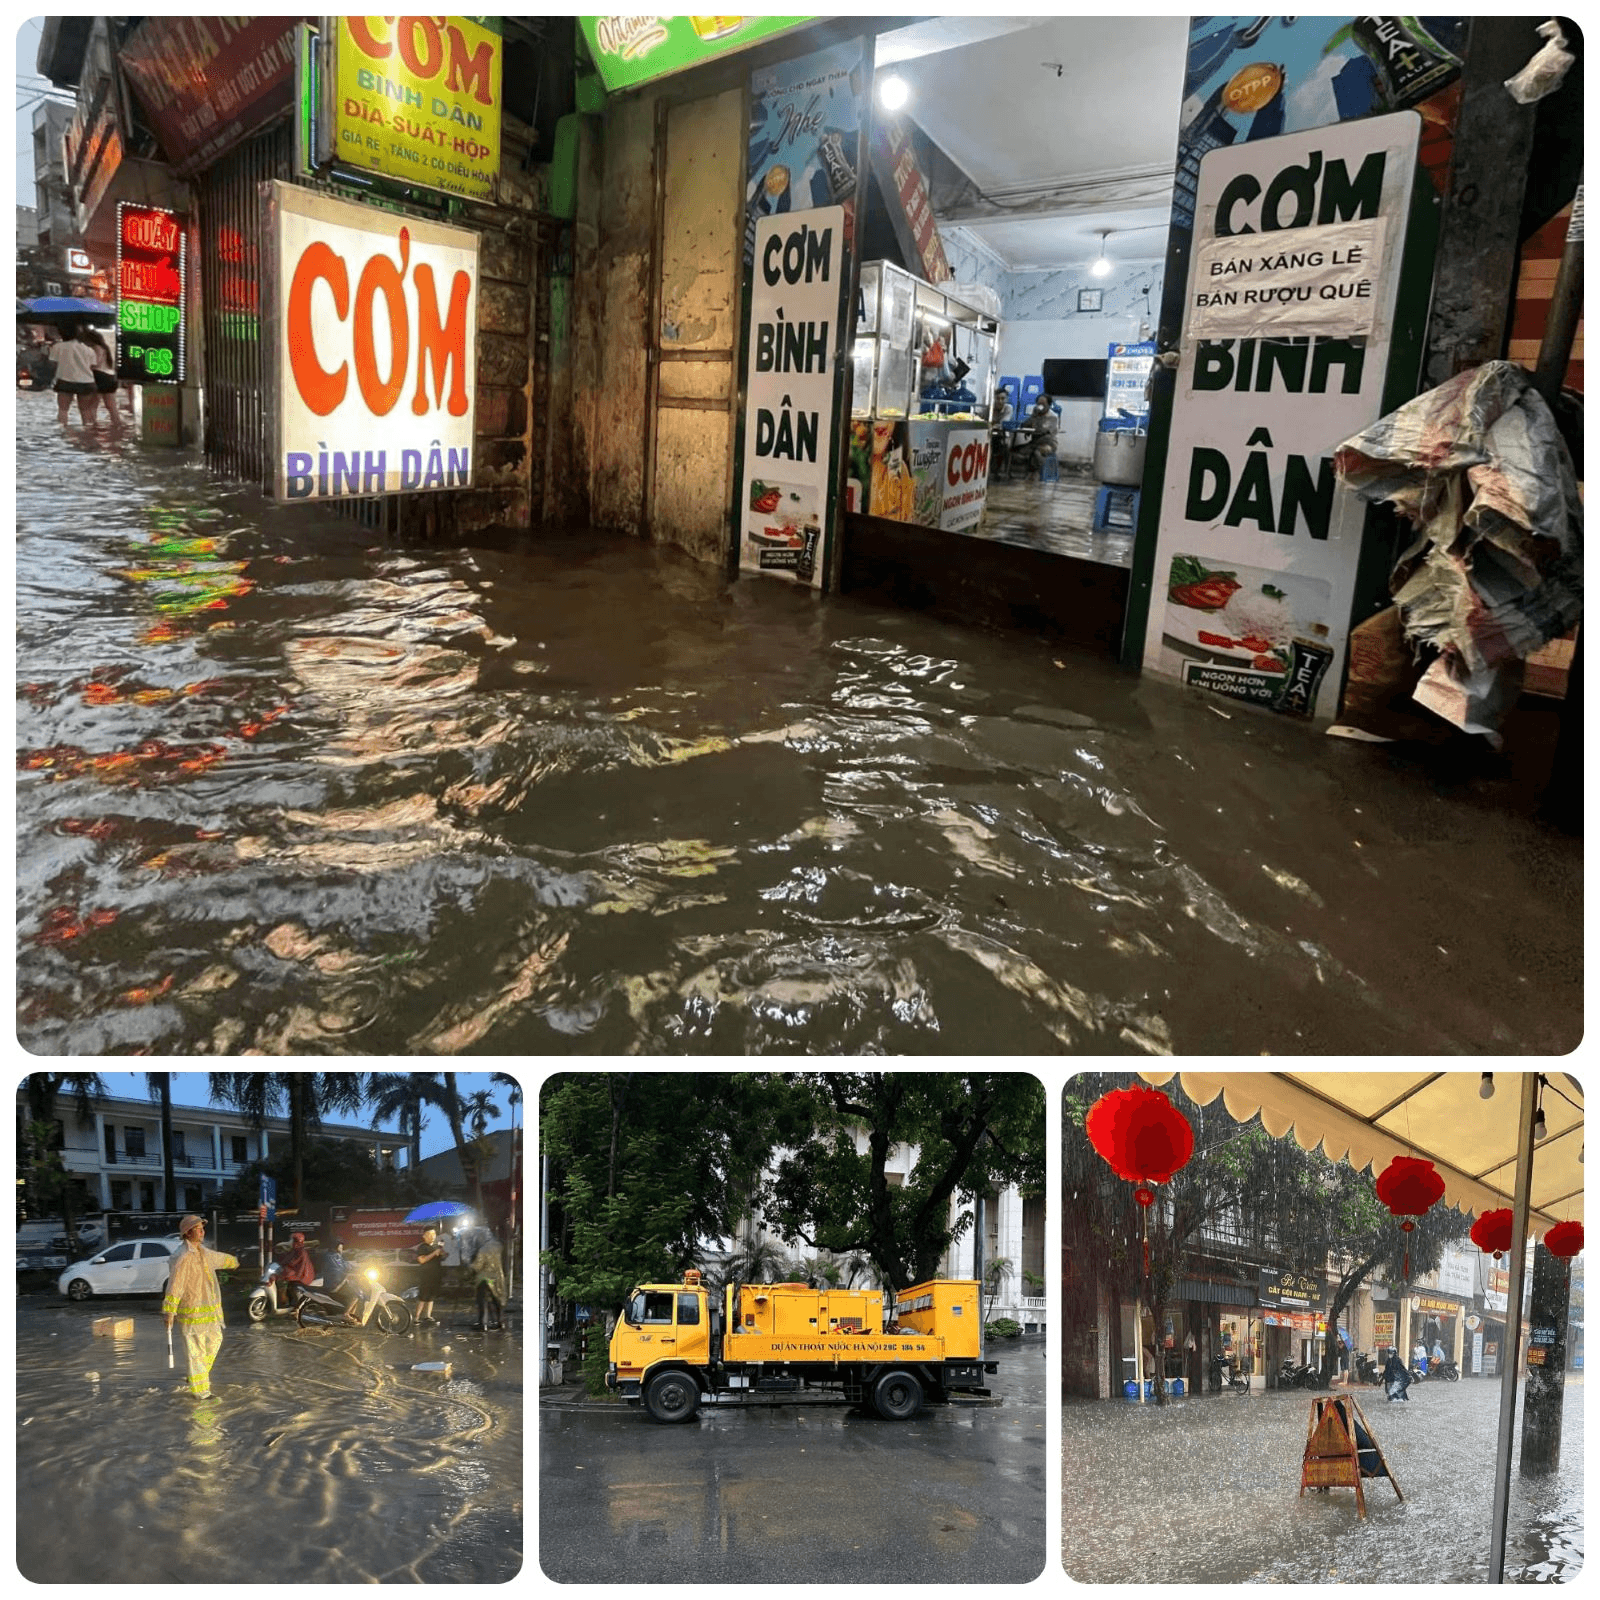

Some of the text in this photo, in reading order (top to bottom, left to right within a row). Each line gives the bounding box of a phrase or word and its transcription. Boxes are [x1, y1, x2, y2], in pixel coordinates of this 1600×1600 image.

[356, 67, 483, 132] BÌNH DÂN
[1229, 75, 1272, 101] OTPP
[1214, 150, 1388, 238] CƠM
[763, 224, 833, 287] CƠM
[1210, 244, 1363, 276] BÁN XĂNG LẺ
[122, 301, 181, 333] SHOP
[287, 226, 472, 417] CƠM
[1196, 279, 1373, 308] BÁN RƯỢU QUÊ
[756, 306, 829, 374] BÌNH
[755, 394, 819, 463] DÂN
[287, 439, 469, 499] BÌNH DÂN
[947, 439, 990, 487] CƠM
[1185, 427, 1336, 541] DÂN
[1201, 670, 1267, 687] NGON HƠN
[771, 1341, 784, 1353] DỰ
[784, 1340, 798, 1351] ÁN
[799, 1340, 826, 1351] THOÁT
[827, 1339, 851, 1351] NƯỚC
[853, 1340, 866, 1351] HÀ
[867, 1341, 882, 1353] NỘI
